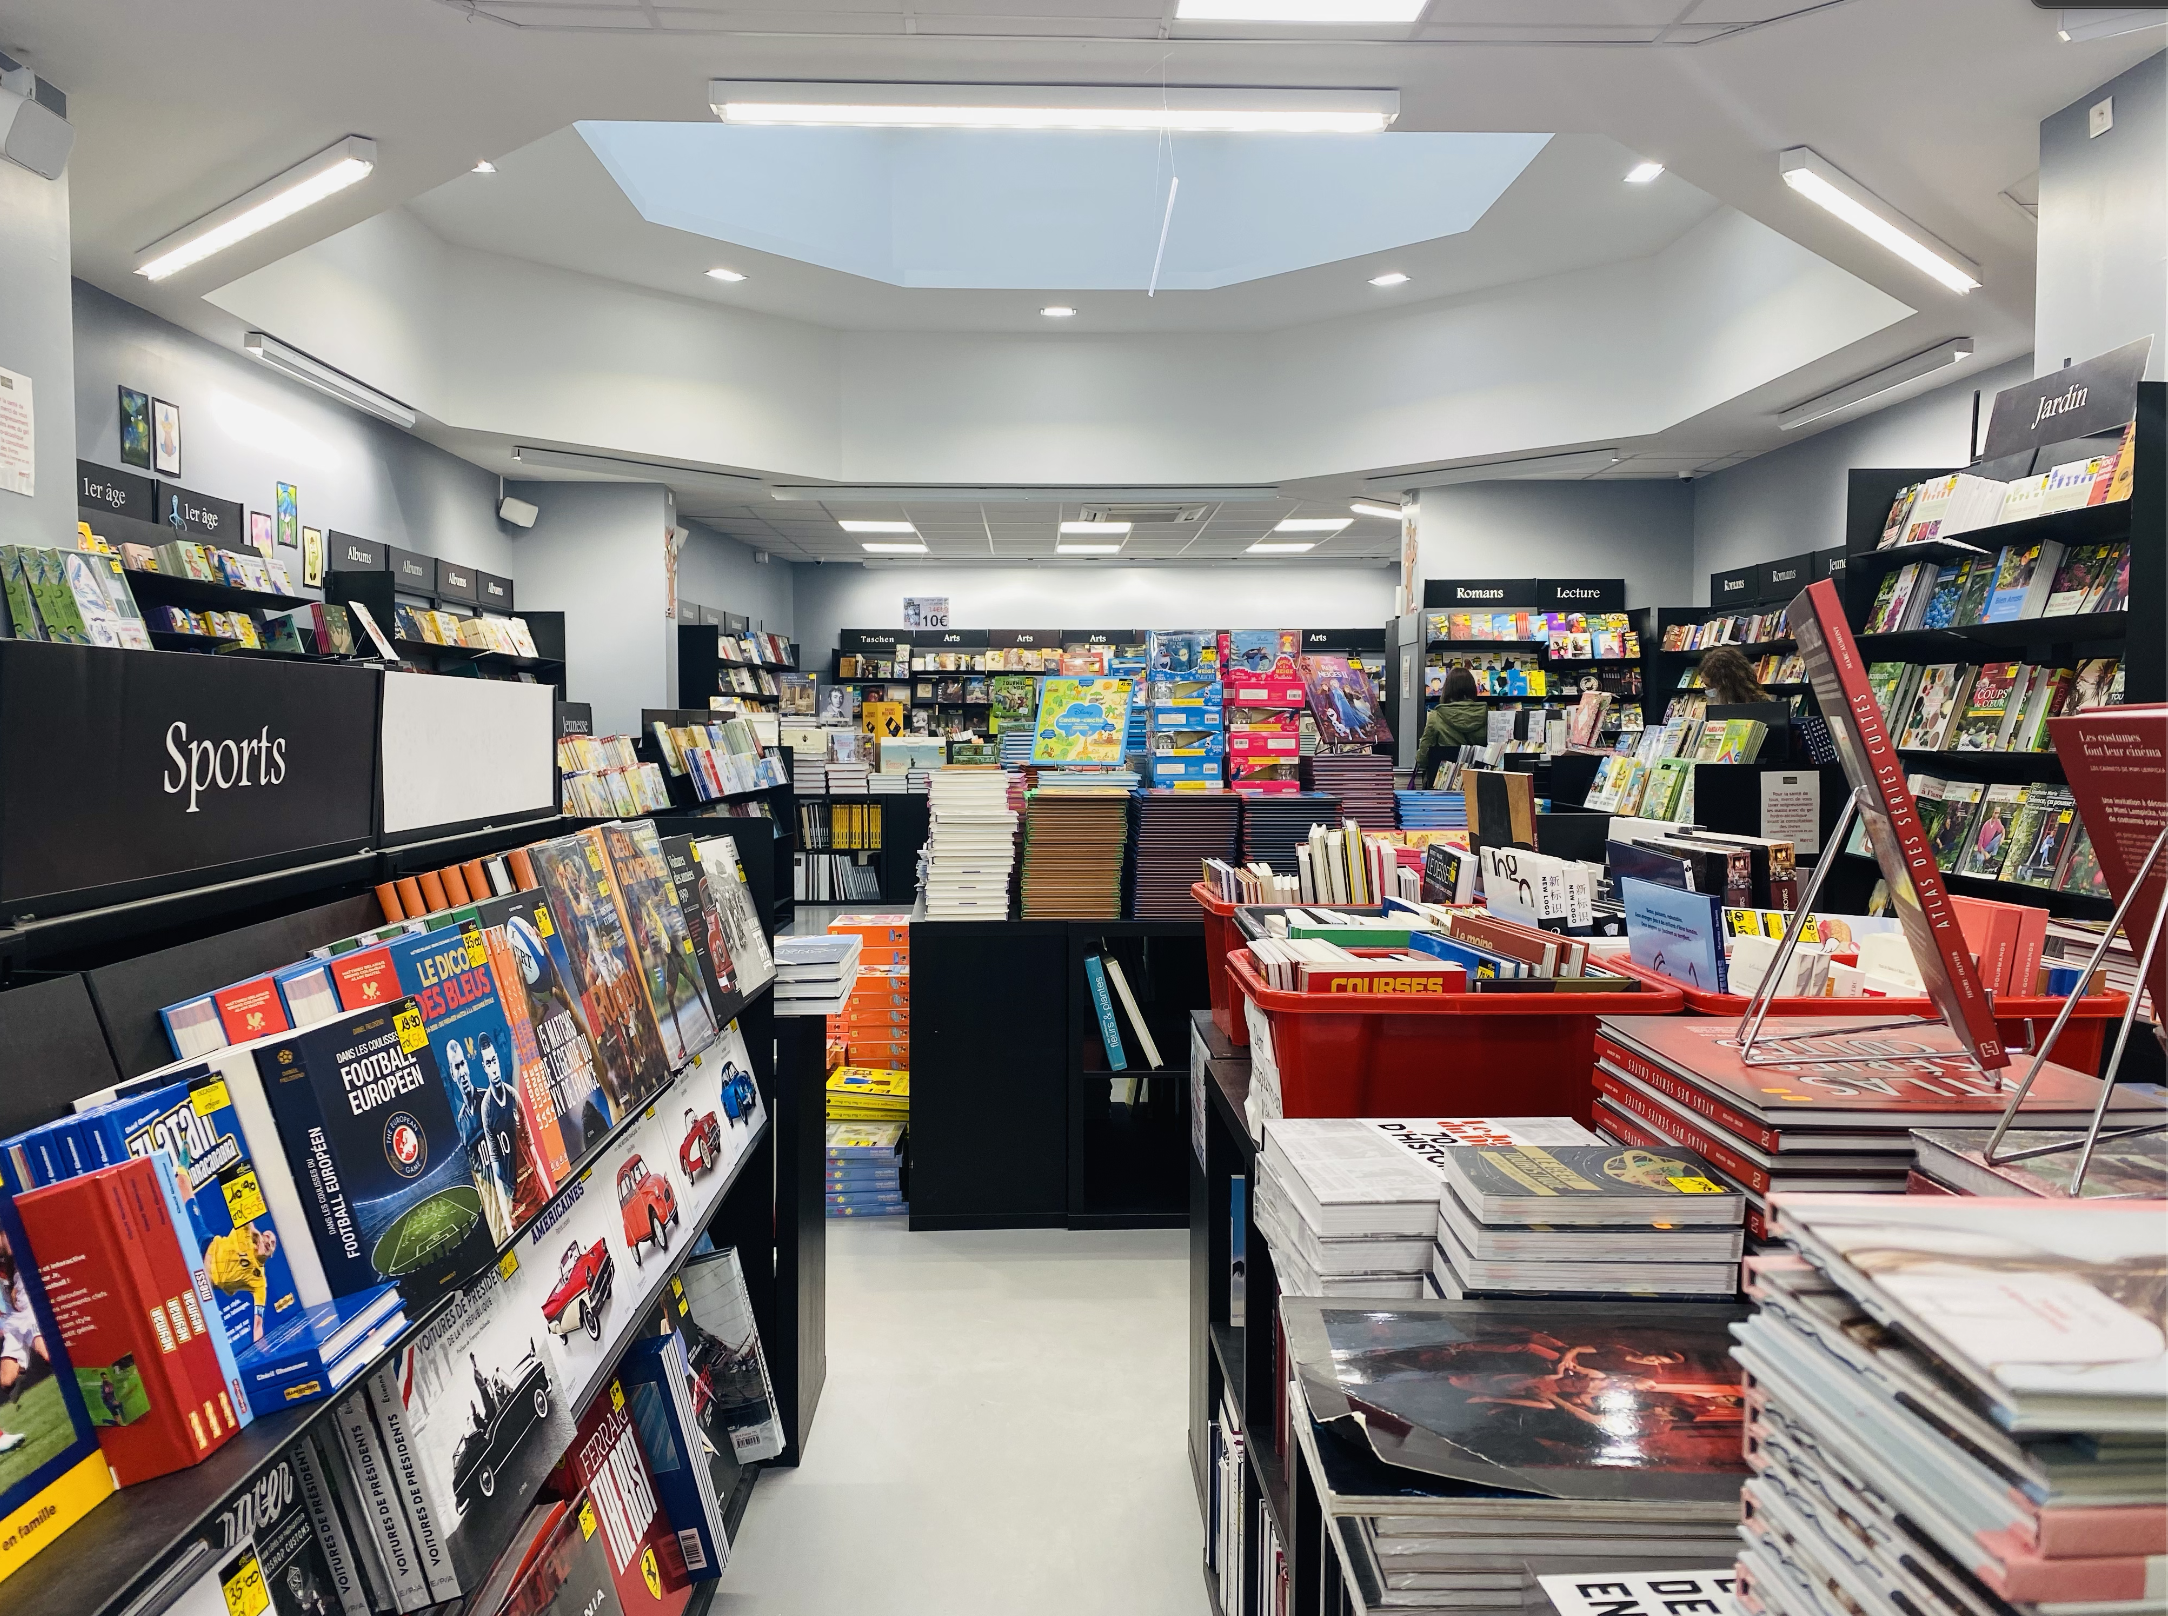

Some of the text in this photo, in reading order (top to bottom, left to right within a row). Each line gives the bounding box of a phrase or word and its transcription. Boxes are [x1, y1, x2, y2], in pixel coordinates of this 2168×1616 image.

[2031, 384, 2088, 429] Jardin
[83, 478, 126, 508] 1er âge
[184, 504, 218, 530] 1er âge
[348, 546, 372, 565] Albums
[402, 560, 423, 577] Albums
[448, 573, 467, 588] Albums
[1724, 579, 1745, 592] Romans
[1772, 569, 1797, 582] Romans
[488, 582, 504, 597] Albums
[1456, 587, 1504, 599] Romans
[1556, 587, 1601, 599] Lecture
[922, 614, 948, 628] 10€
[860, 635, 895, 643] Taschen
[943, 634, 961, 643] Arts
[1016, 634, 1034, 643] Arts
[1089, 634, 1107, 643] Arts
[1309, 633, 1327, 642] Arts
[1977, 688, 2008, 700] COUPS
[562, 716, 588, 736] Jeunesse
[2079, 731, 2141, 743] Les costumes
[2104, 744, 2124, 757] leur
[2126, 745, 2162, 758] cinéma
[163, 721, 286, 813] Sports
[1853, 693, 1950, 928] ATLAS DES SÉRIES CULTES
[1456, 928, 1466, 940] Le
[416, 958, 439, 988] LE
[434, 946, 471, 980] DICO
[1994, 942, 2006, 987] GOURMANDS
[2023, 942, 2035, 987] GOURMANDS
[414, 966, 491, 1023] DES BLEUS
[1096, 976, 1112, 1012] plantes
[1331, 977, 1444, 993] COURSES
[537, 1009, 577, 1055] 15 MATCHS
[1107, 1021, 1119, 1048] fleurs
[336, 1030, 400, 1064] DANS LES COULISSES
[578, 1032, 592, 1062] DU
[340, 1045, 417, 1091] FOOTBALL
[348, 1064, 425, 1116] EUROPÉEN
[550, 1084, 566, 1119] XV
[560, 1078, 577, 1110] DE
[571, 1061, 601, 1106] FRANCE
[1627, 1058, 1715, 1116] ATLAS DES SÉRIES CULTES
[390, 1115, 419, 1132] EUROPEAN
[1624, 1093, 1708, 1155] ATLAS DES SÉRIES CULTES
[496, 1131, 510, 1156] 10
[1420, 1132, 1459, 1145] 70
[405, 1161, 422, 1174] GAME
[478, 1140, 490, 1169] 10
[308, 1126, 360, 1259] FOOTBALL EUROPÉEN
[309, 1168, 327, 1205] COULISSES
[320, 1203, 331, 1217] LES
[529, 1181, 585, 1246] AMERICAINES
[324, 1217, 337, 1235] DANS
[415, 1298, 467, 1355] VOITURES DE
[351, 1424, 409, 1577] VOITURES DE PRÉSIDENTS
[388, 1414, 441, 1567] VOITURES DE PRÉSIDENTS
[589, 1424, 658, 1577] THE BEST
[1, 1503, 57, 1552] en famille
[285, 1522, 311, 1553] CUSTOMS
[317, 1516, 331, 1534] DE
[325, 1535, 351, 1595] VOITURES
